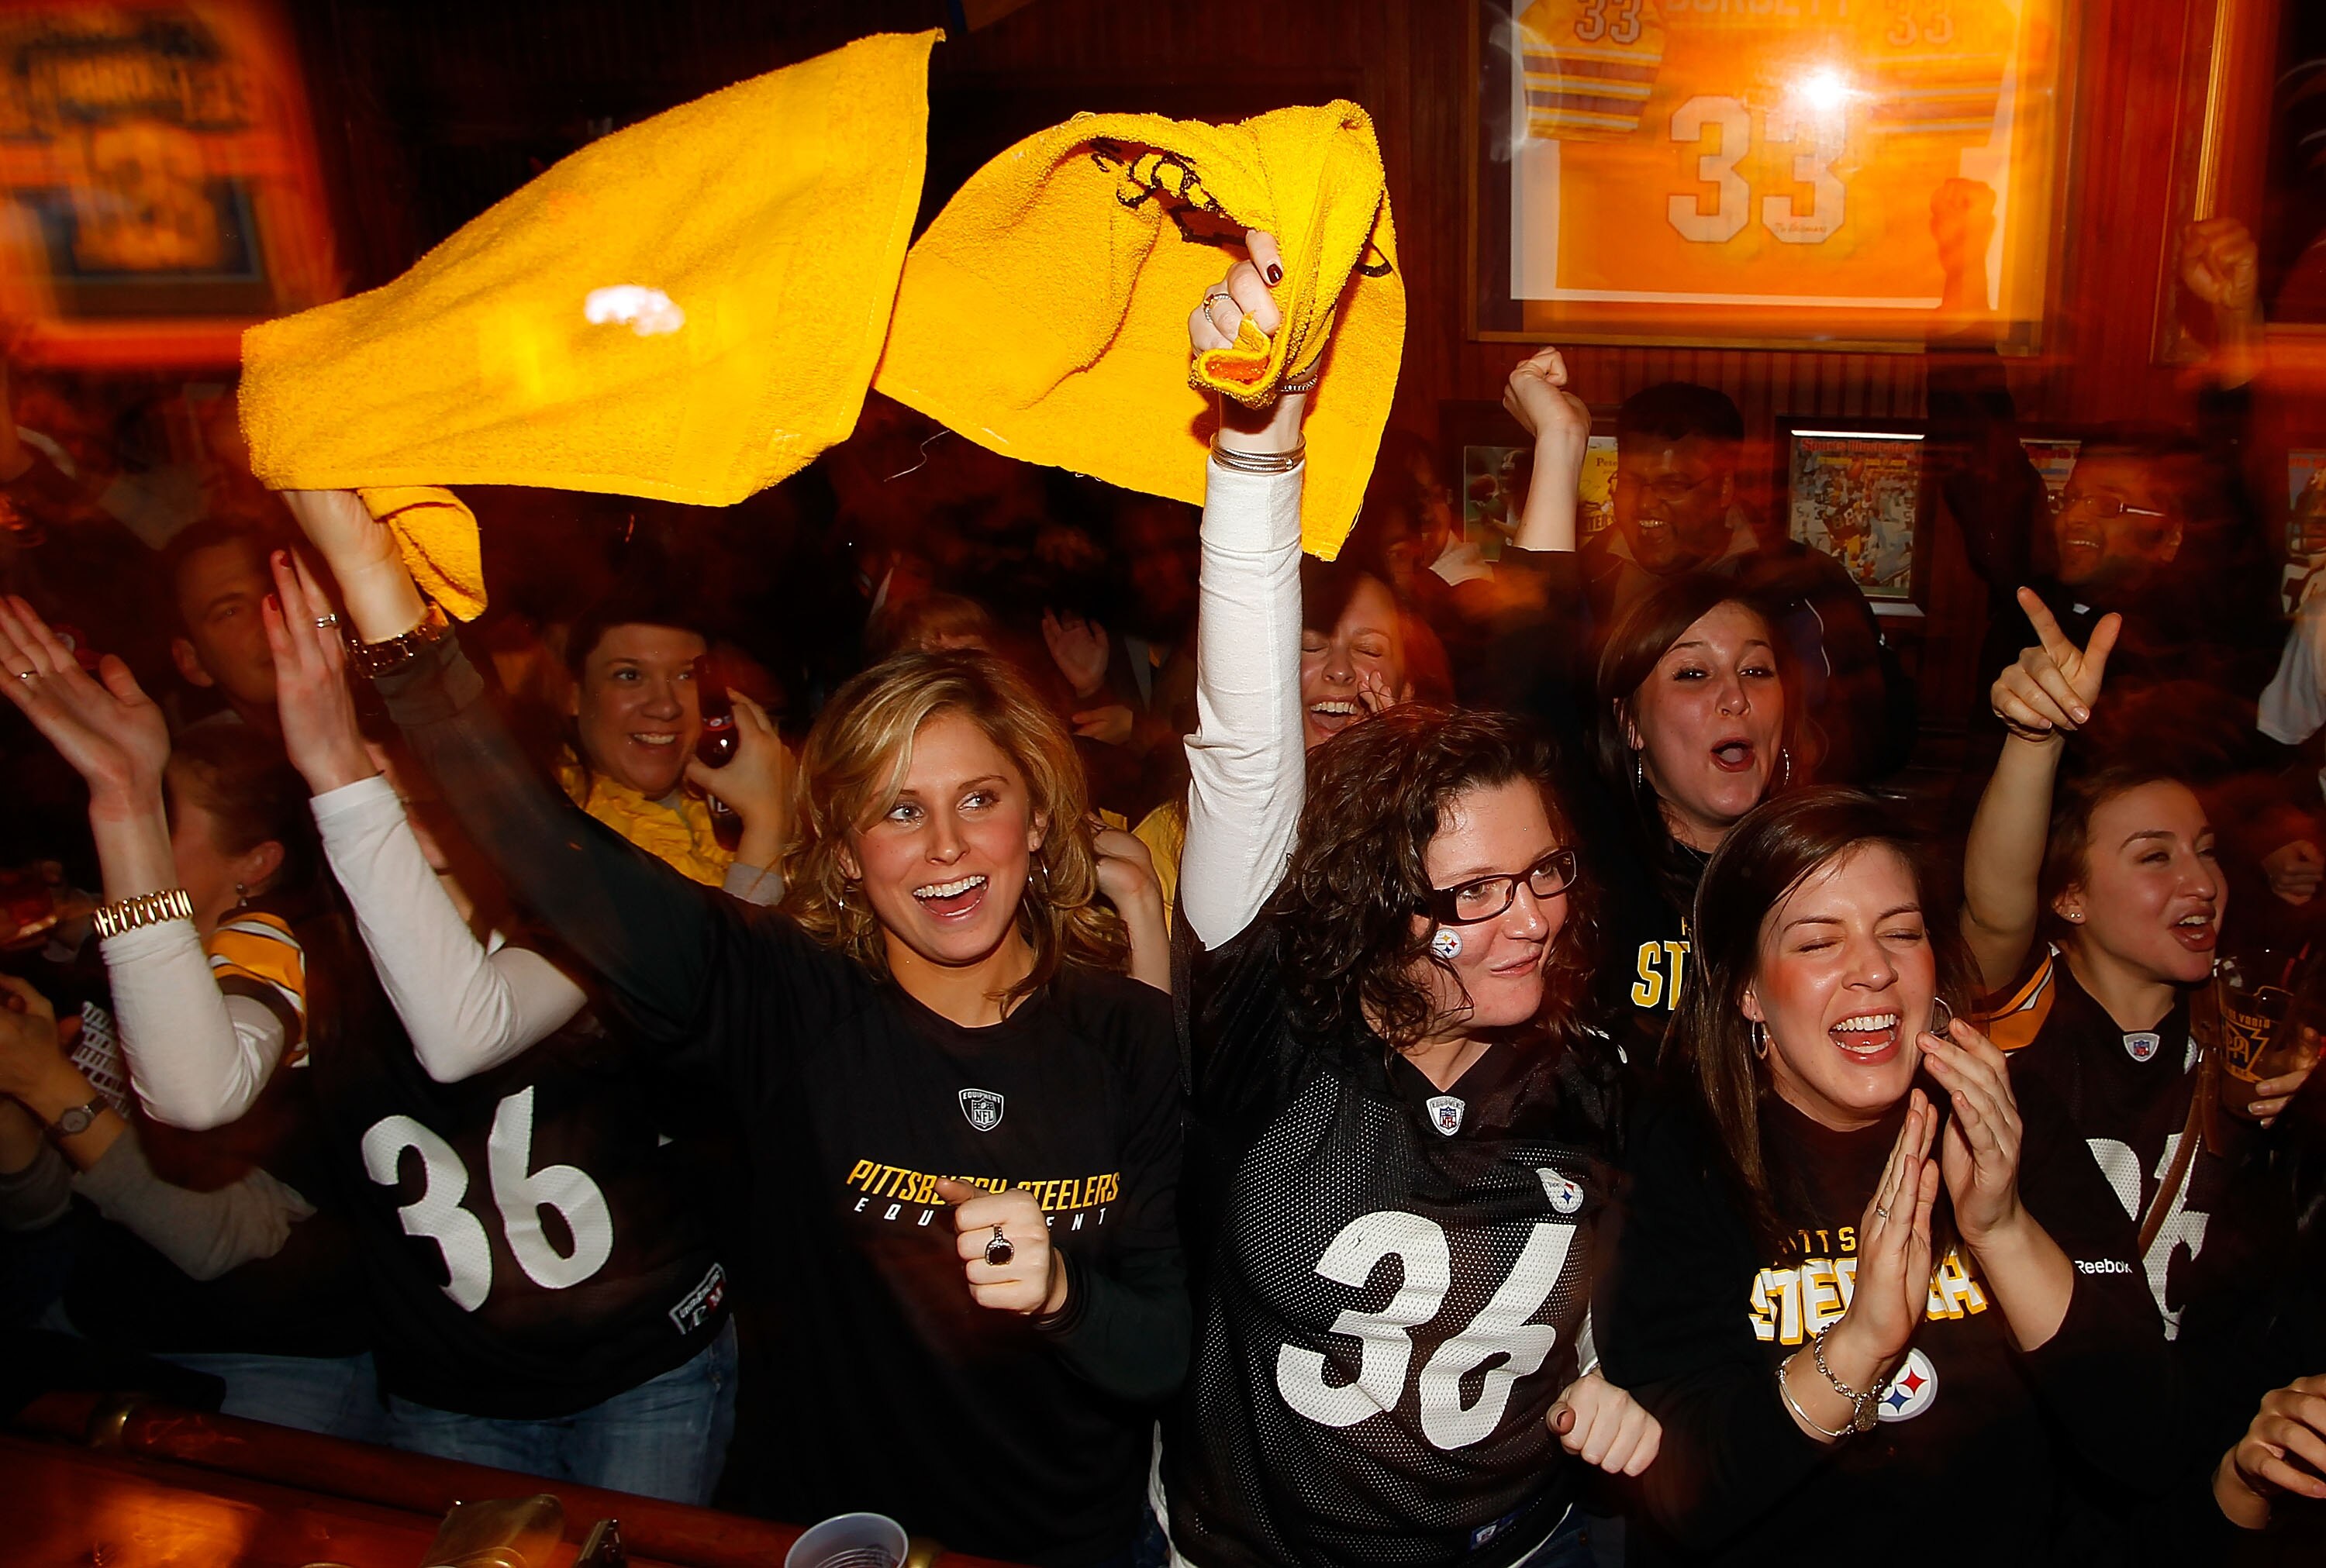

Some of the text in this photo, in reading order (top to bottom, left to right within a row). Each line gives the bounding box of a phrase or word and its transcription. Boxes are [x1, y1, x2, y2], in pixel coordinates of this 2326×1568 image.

[1575, 0, 1642, 44] 33
[1668, 95, 1845, 244] 33
[975, 1110, 993, 1123] NFL
[361, 1085, 614, 1311] 36
[2074, 1258, 2133, 1274] Reebok
[1276, 1211, 1577, 1450] 36
